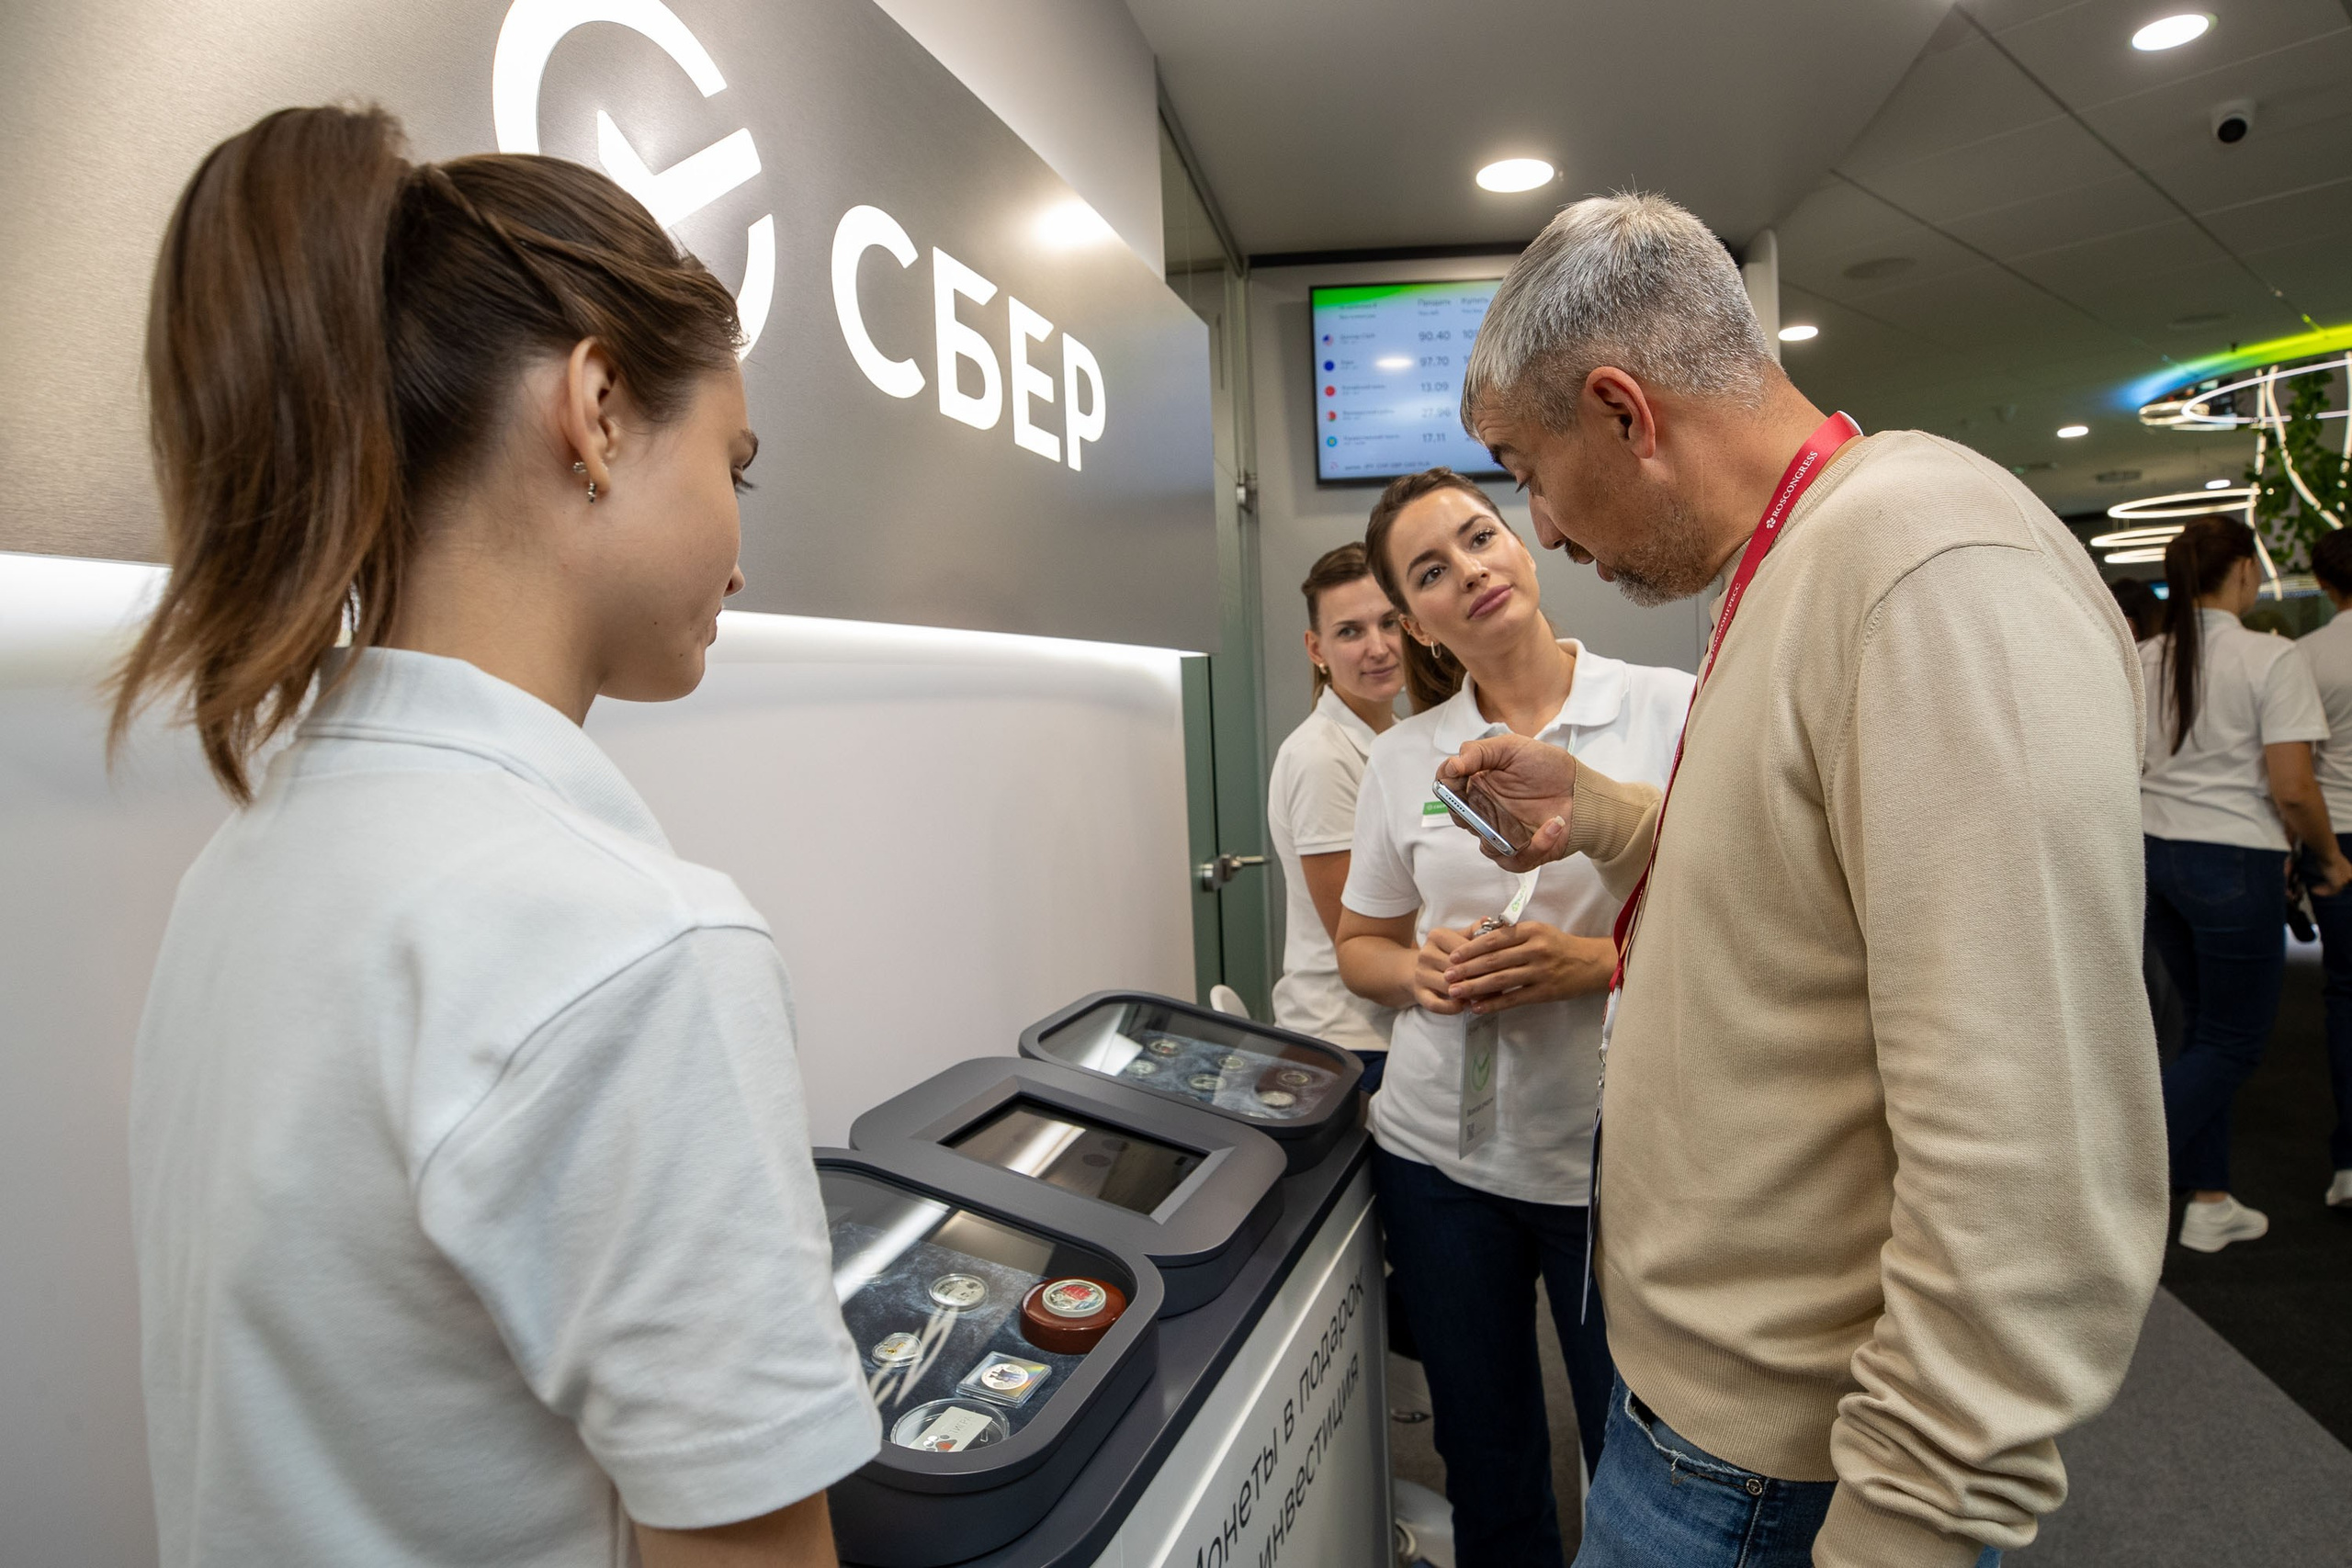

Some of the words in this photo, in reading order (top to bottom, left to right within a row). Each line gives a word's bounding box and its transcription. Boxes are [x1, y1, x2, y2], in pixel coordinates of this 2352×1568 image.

[831, 204, 1107, 472] СБЕР
[1771, 450, 1819, 518] ROSCONGRESS
[1196, 1427, 1278, 1568] онеты
[1283, 1398, 1295, 1445] в
[1299, 1265, 1364, 1415] подарок
[1260, 1351, 1360, 1568] инвестиция
